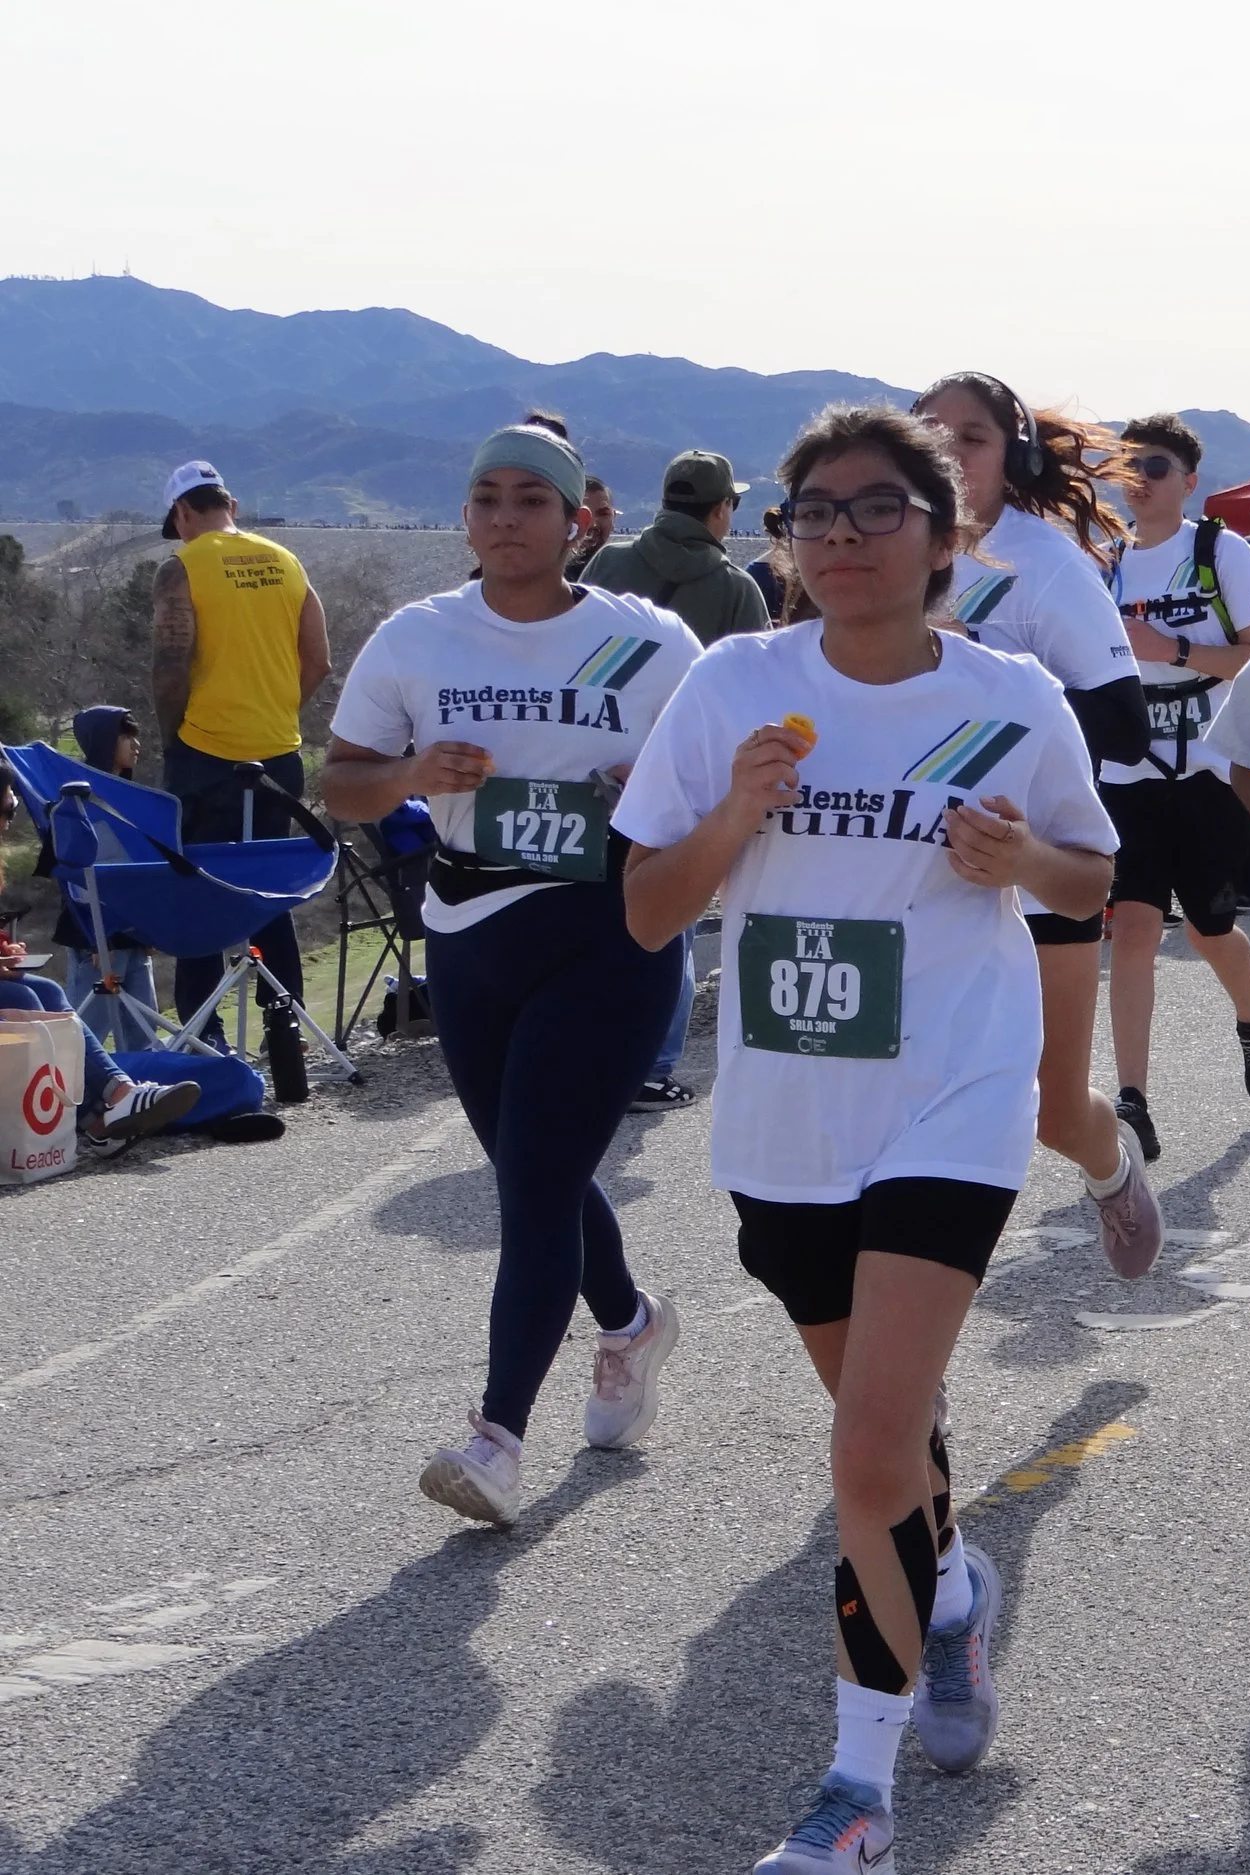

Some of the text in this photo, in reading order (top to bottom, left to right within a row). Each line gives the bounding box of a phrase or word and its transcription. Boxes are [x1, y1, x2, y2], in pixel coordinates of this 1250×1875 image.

[247, 568, 265, 577] For
[235, 579, 259, 590] Long
[438, 686, 553, 706] Students
[438, 688, 624, 733] run LA
[528, 781, 559, 790] Students
[528, 792, 558, 811] LA
[496, 810, 586, 855] 1272
[796, 920, 835, 930] Students
[797, 928, 833, 938] run
[795, 935, 833, 960] LA
[770, 959, 861, 1021] 879
[789, 1018, 837, 1034] SRLA 30K
[11, 1148, 66, 1170] Leader
